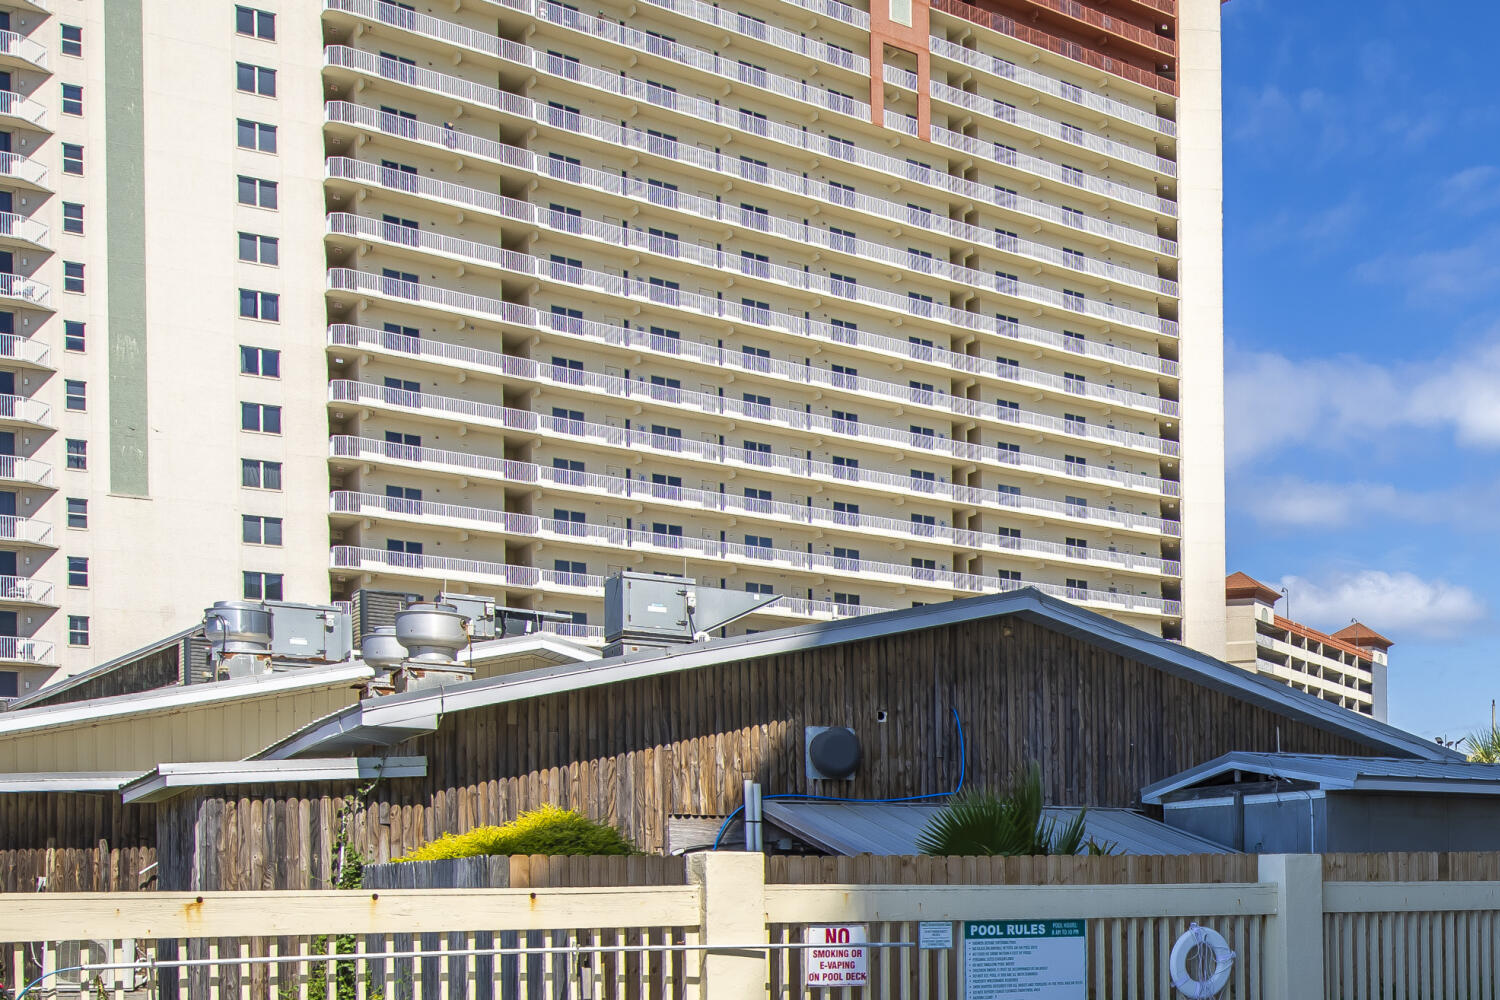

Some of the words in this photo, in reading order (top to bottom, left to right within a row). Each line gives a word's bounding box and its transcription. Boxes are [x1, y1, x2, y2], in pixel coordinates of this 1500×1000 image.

[970, 925, 1004, 936] POOL
[1007, 924, 1046, 935] RULES
[825, 928, 850, 944] NO
[813, 949, 849, 958] SMOKING
[851, 949, 862, 957] OR
[819, 961, 856, 969] E-VAPING
[808, 973, 819, 981] ON
[822, 972, 843, 981] POOL
[845, 972, 867, 980] DECK
